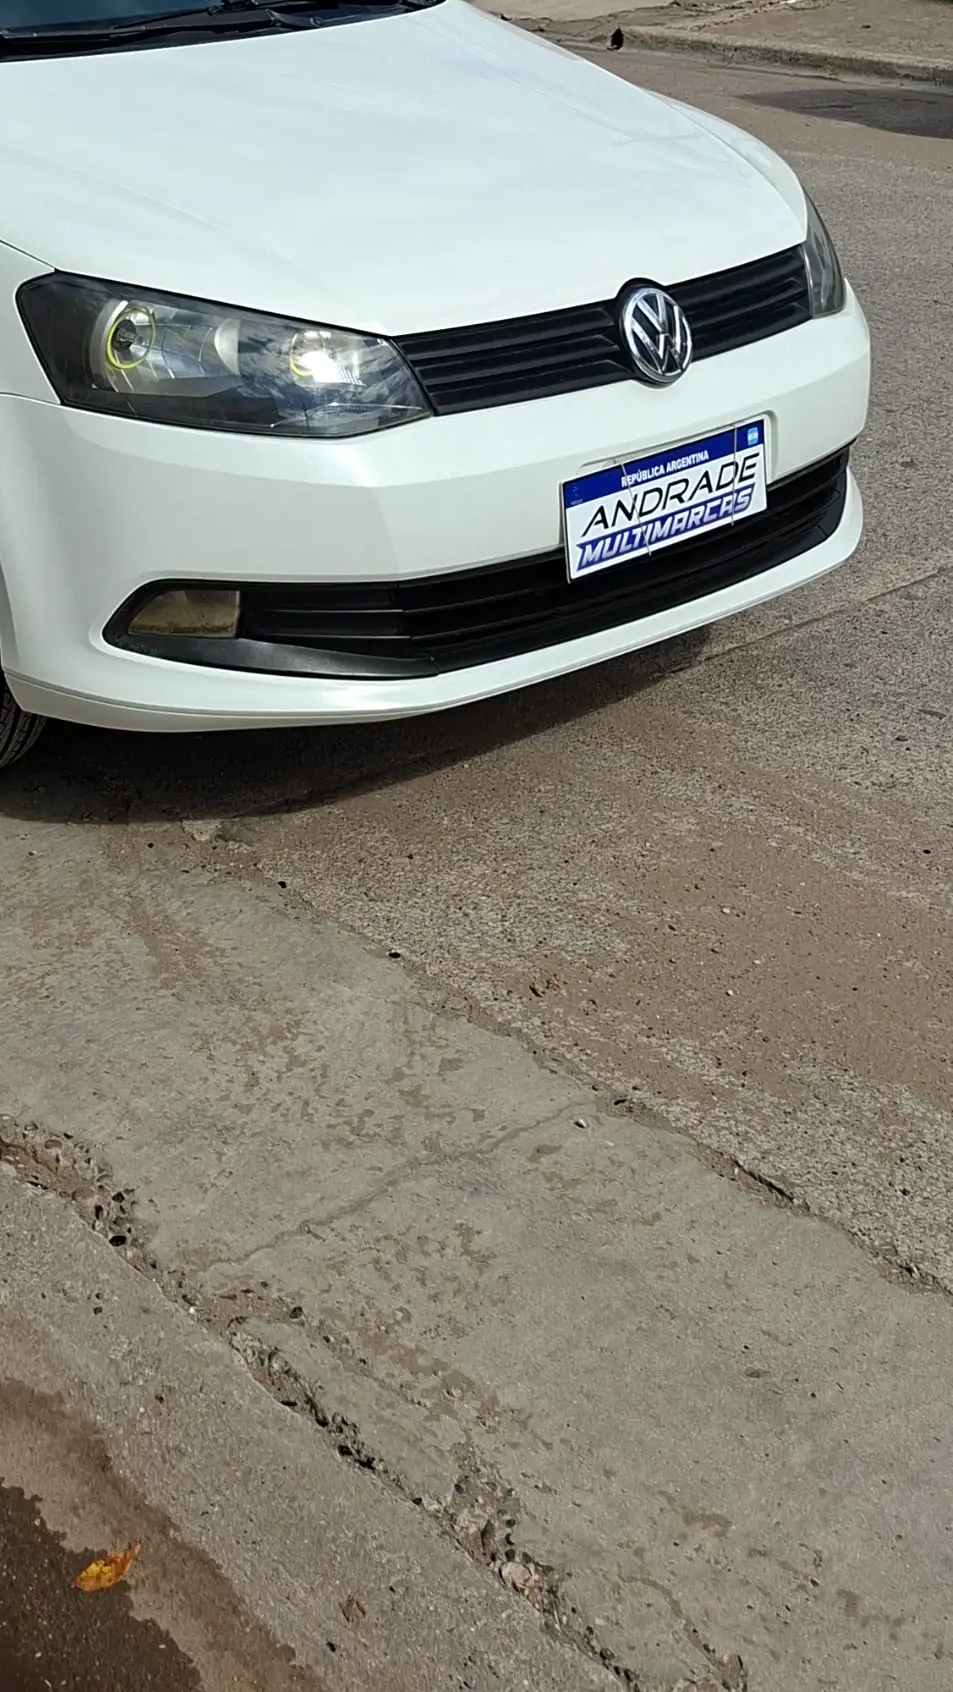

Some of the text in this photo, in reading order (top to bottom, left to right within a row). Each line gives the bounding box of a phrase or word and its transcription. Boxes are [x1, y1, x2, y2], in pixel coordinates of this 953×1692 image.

[581, 451, 760, 539] ANDRADE
[621, 449, 710, 488] REPÚBLICA ARGENTINA
[580, 488, 752, 567] MULTIMARCAS
